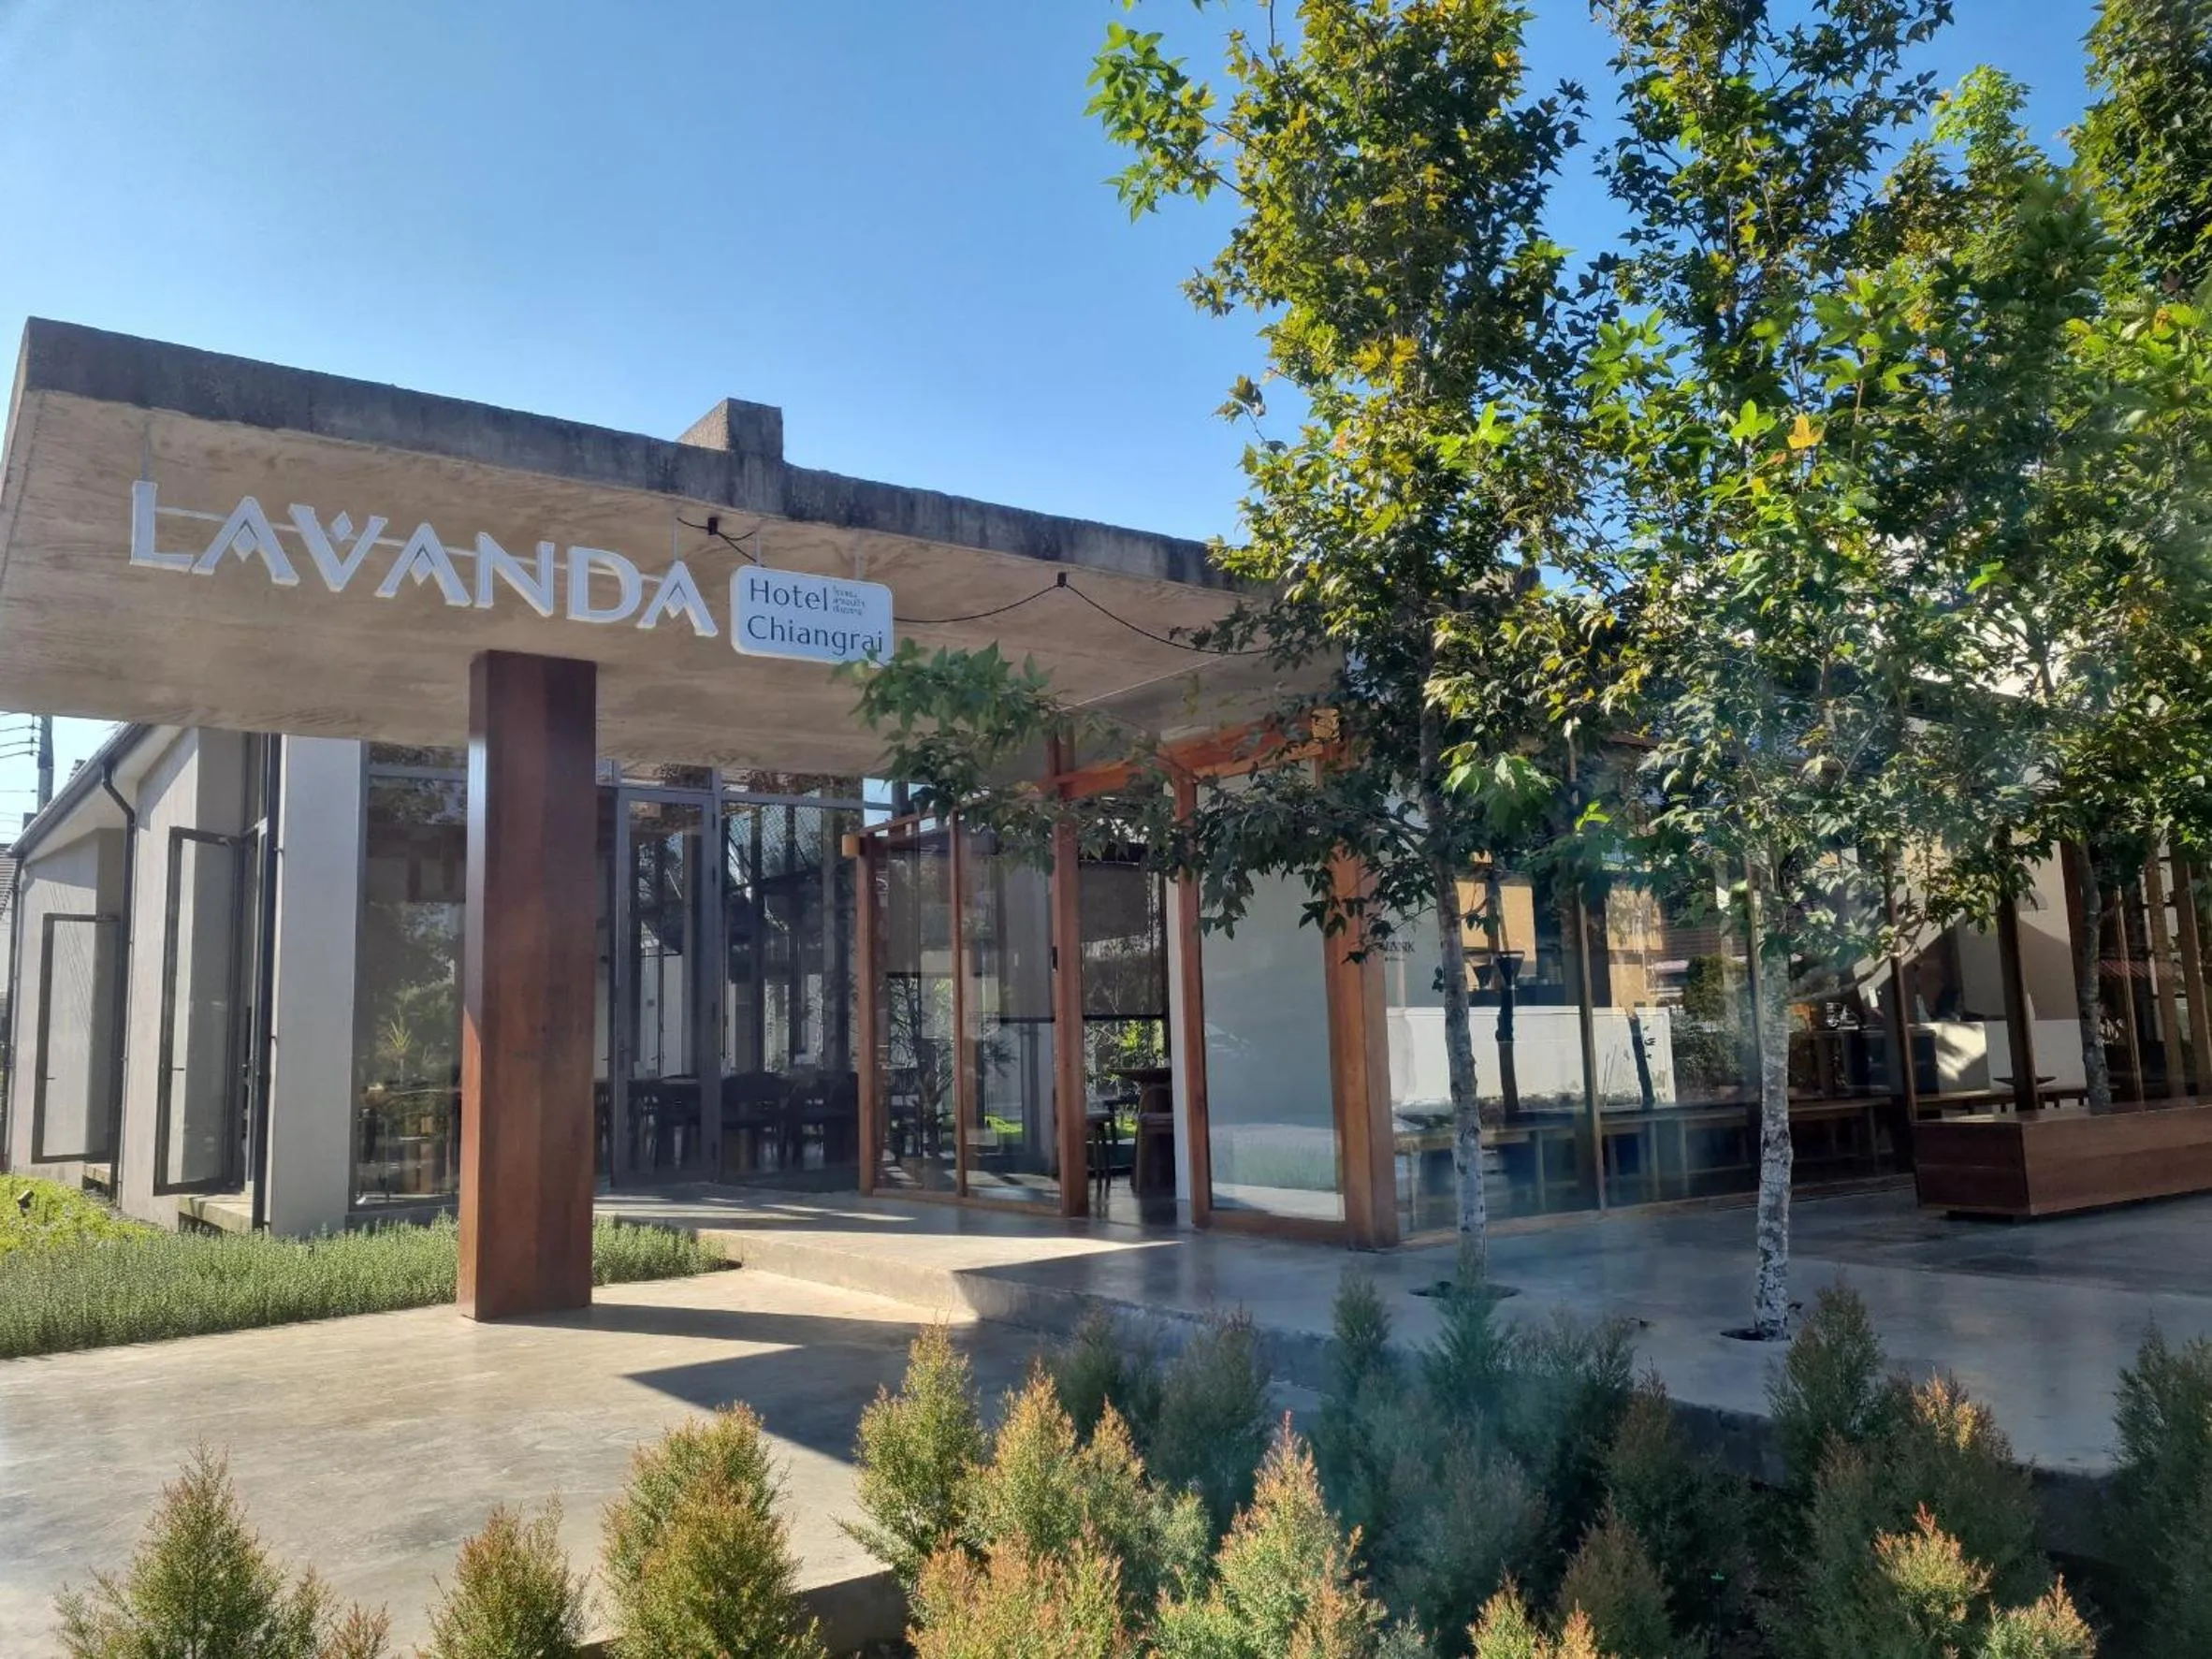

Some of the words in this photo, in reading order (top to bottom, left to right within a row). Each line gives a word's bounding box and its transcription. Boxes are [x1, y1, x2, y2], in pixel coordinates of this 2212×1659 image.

[130, 480, 718, 637] LAVANDA
[750, 577, 827, 611] Hotel
[747, 615, 882, 656] Chiangrai
